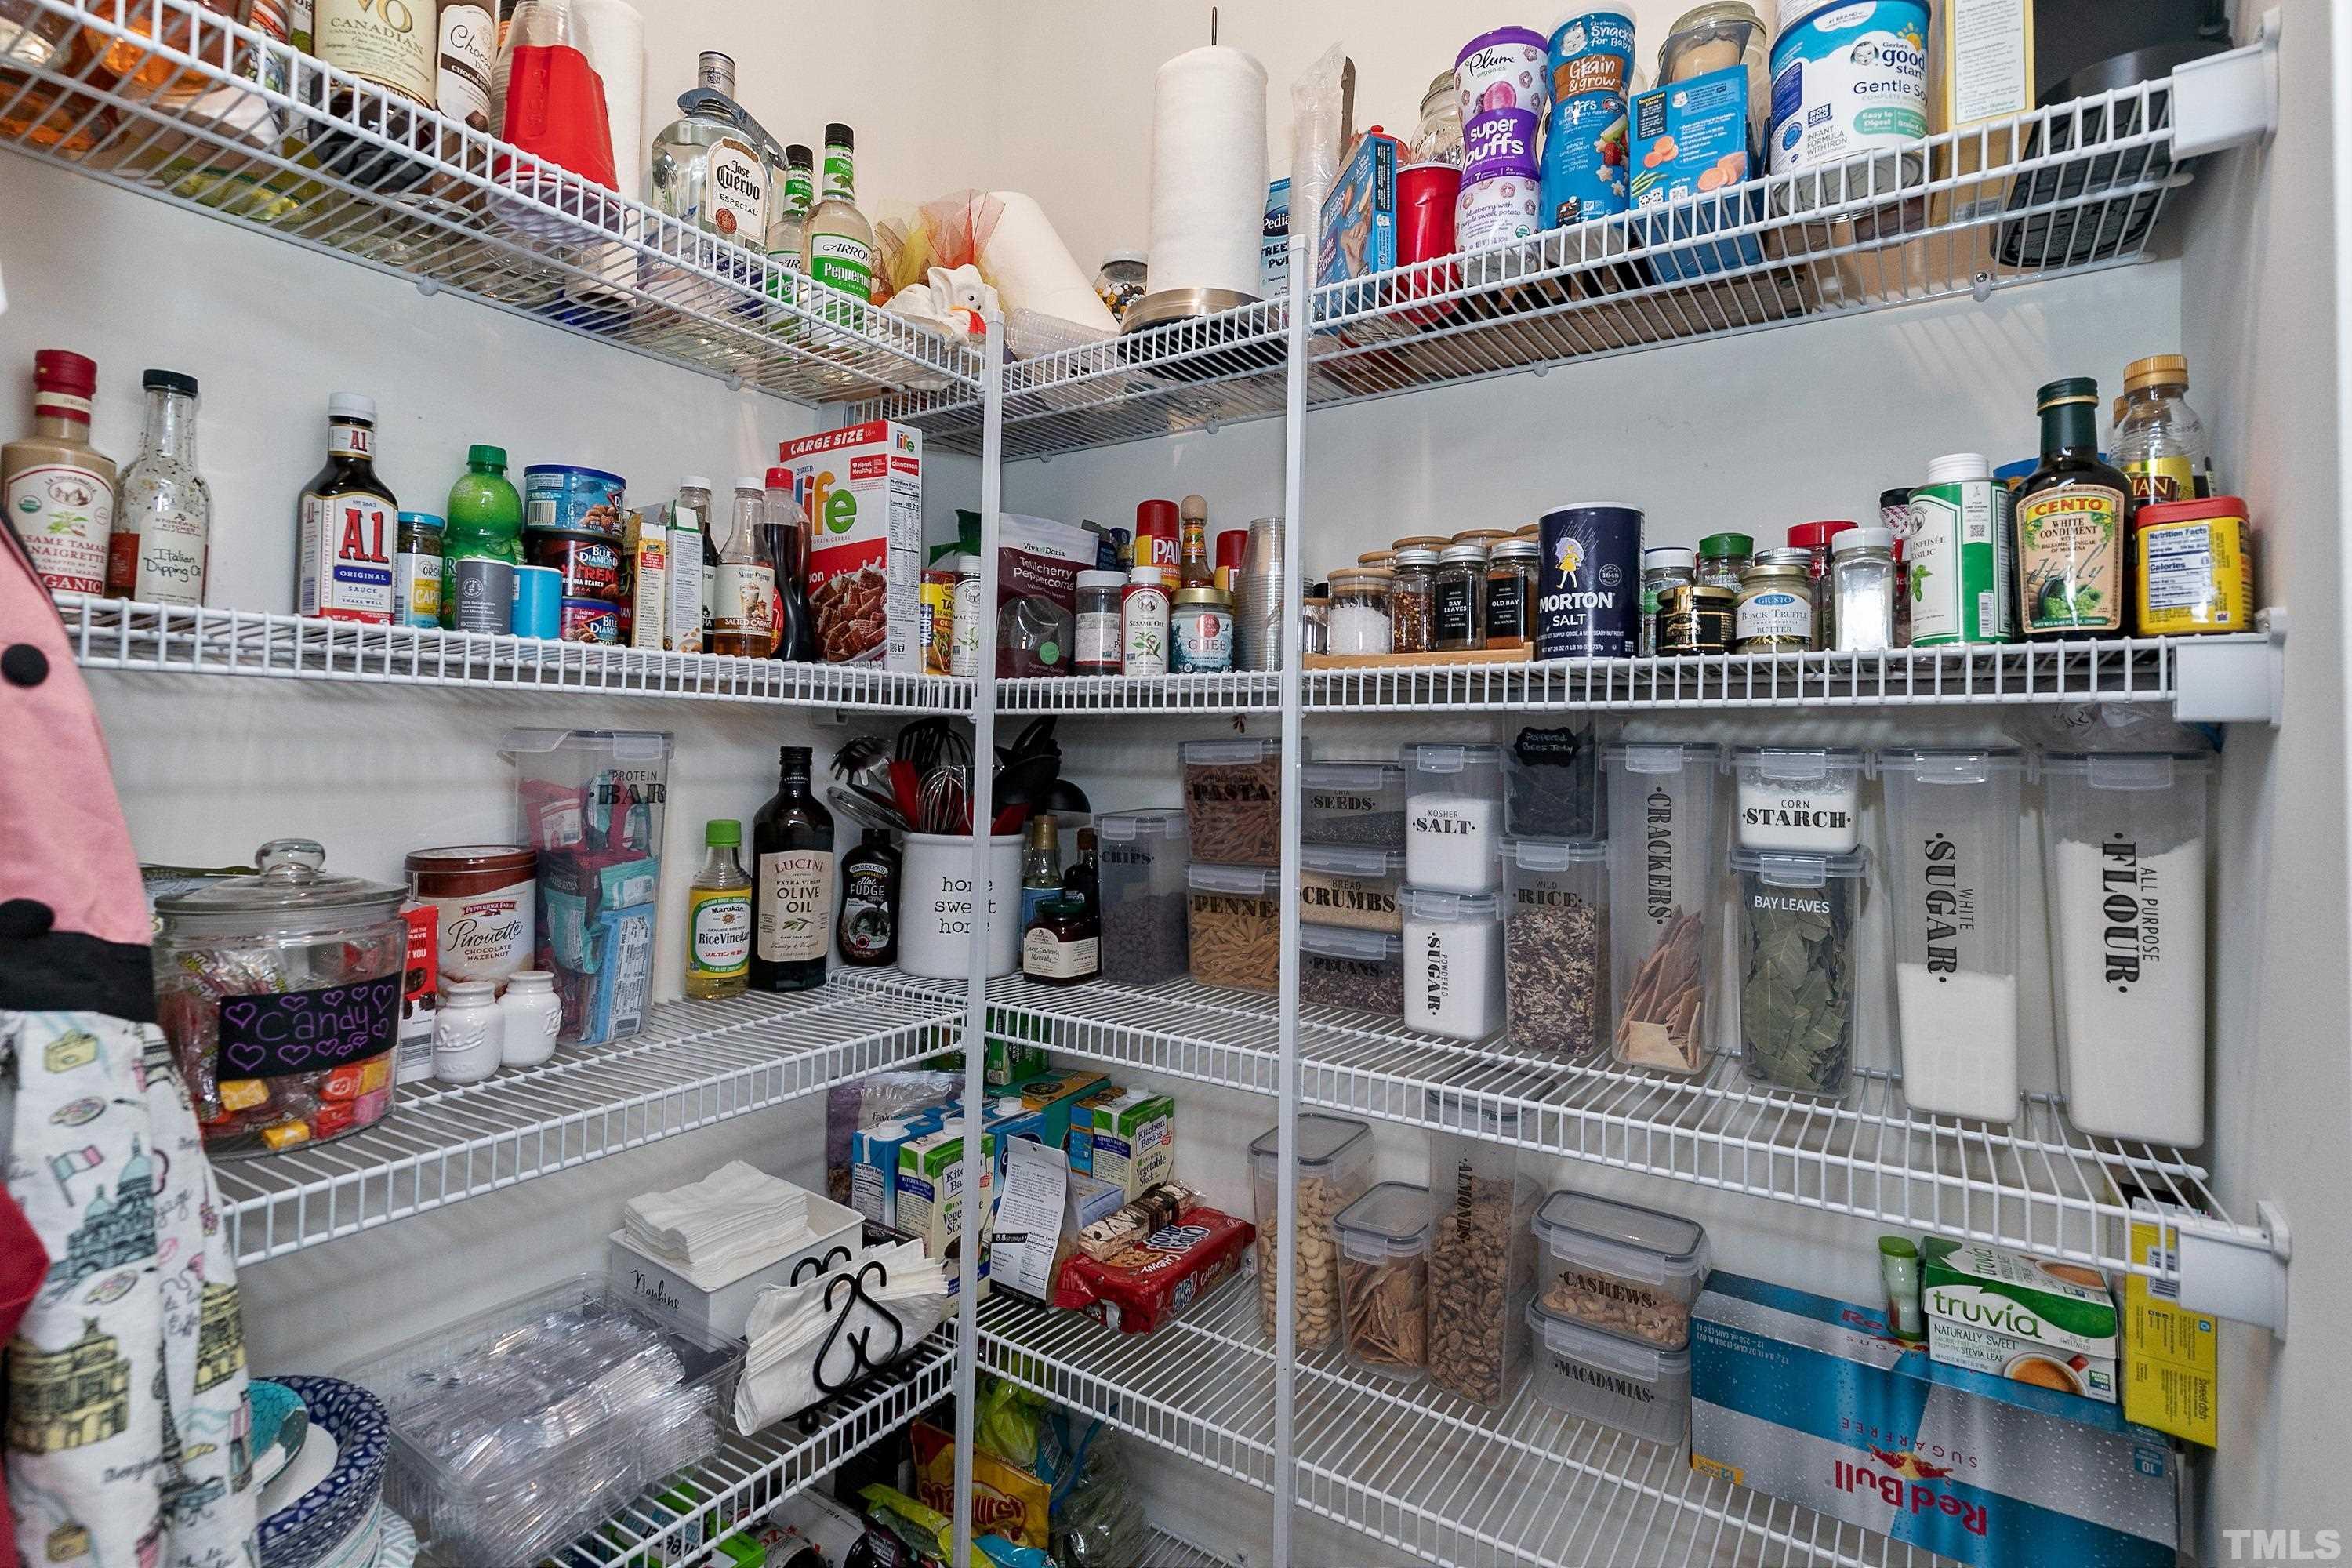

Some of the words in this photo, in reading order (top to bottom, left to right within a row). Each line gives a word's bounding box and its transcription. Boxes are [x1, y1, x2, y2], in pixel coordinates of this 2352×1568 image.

[331, 18, 424, 56] CANADIAN
[1591, 38, 1607, 47] for
[1468, 49, 1515, 77] Plum
[1569, 58, 1616, 78] Grain
[1882, 48, 1925, 70] good
[1477, 65, 1506, 78] organics
[1896, 65, 1922, 80] start
[1853, 80, 1911, 94] Gentle
[1470, 118, 1518, 143] super
[1806, 125, 1834, 142] INFANT
[1806, 130, 1845, 149] FORMULA
[1463, 132, 1524, 175] puffs
[1806, 143, 1826, 156] WITH
[1827, 137, 1848, 151] IRON
[731, 159, 750, 179] Jose
[717, 165, 760, 201] Cuervo
[720, 193, 758, 216] ESPECIAL
[1497, 201, 1513, 211] with
[1477, 212, 1498, 222] sweet
[1499, 209, 1521, 220] potato
[790, 435, 831, 456] LARGE
[833, 428, 864, 446] SIZE
[896, 431, 915, 452] life
[857, 460, 873, 469] Heart
[2034, 498, 2103, 517] CENTO
[2051, 517, 2085, 529] WHITE
[2149, 531, 2183, 539] Nutrition
[592, 547, 612, 558] BLUE
[1023, 543, 1039, 552] Viva
[1045, 546, 1065, 557] Doria
[2041, 541, 2068, 550] BALSAMIC
[579, 552, 619, 568] DIAMOND
[1019, 556, 1073, 580] Tellicherry
[2150, 561, 2186, 572] Calories
[339, 570, 387, 582] ORIGINAL
[1014, 567, 1074, 591] Peppercorns
[347, 586, 378, 594] SAUCE
[1539, 592, 1613, 614] MORTON
[1757, 595, 1792, 604] GIUSTO
[724, 617, 750, 626] SALTED
[1129, 619, 1153, 628] SESAME
[1154, 619, 1164, 628] OIL
[1552, 613, 1588, 627] SALT
[1741, 611, 1768, 621] BLACK
[1773, 608, 1809, 621] TRUFFLE
[1756, 626, 1792, 634] BUTTER
[1188, 639, 1227, 651] GHEE
[612, 771, 658, 782] PROTEIN
[1192, 783, 1272, 802] PASTA
[1313, 795, 1373, 811] SEEDS
[1780, 799, 1809, 809] CORN
[1428, 809, 1459, 819] KOSHER
[1746, 808, 1846, 828] STARCH
[1415, 817, 1472, 835] SALT
[1646, 793, 1673, 919] CRACKERS
[857, 877, 877, 886] Hot
[1331, 877, 1362, 891] BREAD
[1536, 880, 1558, 889] WILD
[2140, 866, 2158, 892] ALL
[776, 886, 820, 900] OLIVE
[850, 884, 884, 896] FUDGE
[1302, 885, 1396, 913] CRUMBS
[1517, 888, 1578, 908] RICE
[466, 903, 499, 914] PEPPERIDGE
[711, 906, 744, 914] Marukan
[786, 902, 812, 913] OIL
[1194, 895, 1275, 918] PENNE
[1754, 895, 1777, 908] BAY
[1781, 897, 1830, 913] LEAVES
[1925, 840, 1958, 975] SUGAR
[1959, 887, 1974, 931] WHITE
[2102, 840, 2140, 984] FLOUR
[446, 918, 524, 952] Pirouette
[699, 931, 720, 945] Rice
[2141, 898, 2160, 962] PURPOSE
[412, 949, 426, 958] YOU
[464, 944, 512, 956] CHOCOLATE
[467, 953, 510, 962] HAZELNUT
[1312, 956, 1381, 978] PECANS
[1427, 936, 1442, 1013] SUGAR
[256, 1004, 372, 1042] Candy
[1138, 1120, 1165, 1141] Kitchen
[1141, 1130, 1163, 1149] Basics
[1137, 1155, 1167, 1178] Vegetable
[1139, 1172, 1155, 1187] Stock
[1457, 1160, 1473, 1241] ALMONDS
[1139, 1254, 1181, 1274] CHEWY
[1563, 1271, 1653, 1309] CASHEWS
[1933, 1323, 1983, 1343] NATURALLY
[1986, 1336, 2019, 1350] SWEET
[1960, 1346, 1984, 1359] STEVIA
[1986, 1352, 2005, 1362] LEAF
[1559, 1360, 1650, 1403] MACADAMIAS
[1840, 1416, 1980, 1470] SUGARFREE
[1833, 1457, 1905, 1509] Bull
[1909, 1486, 1987, 1537] Red
